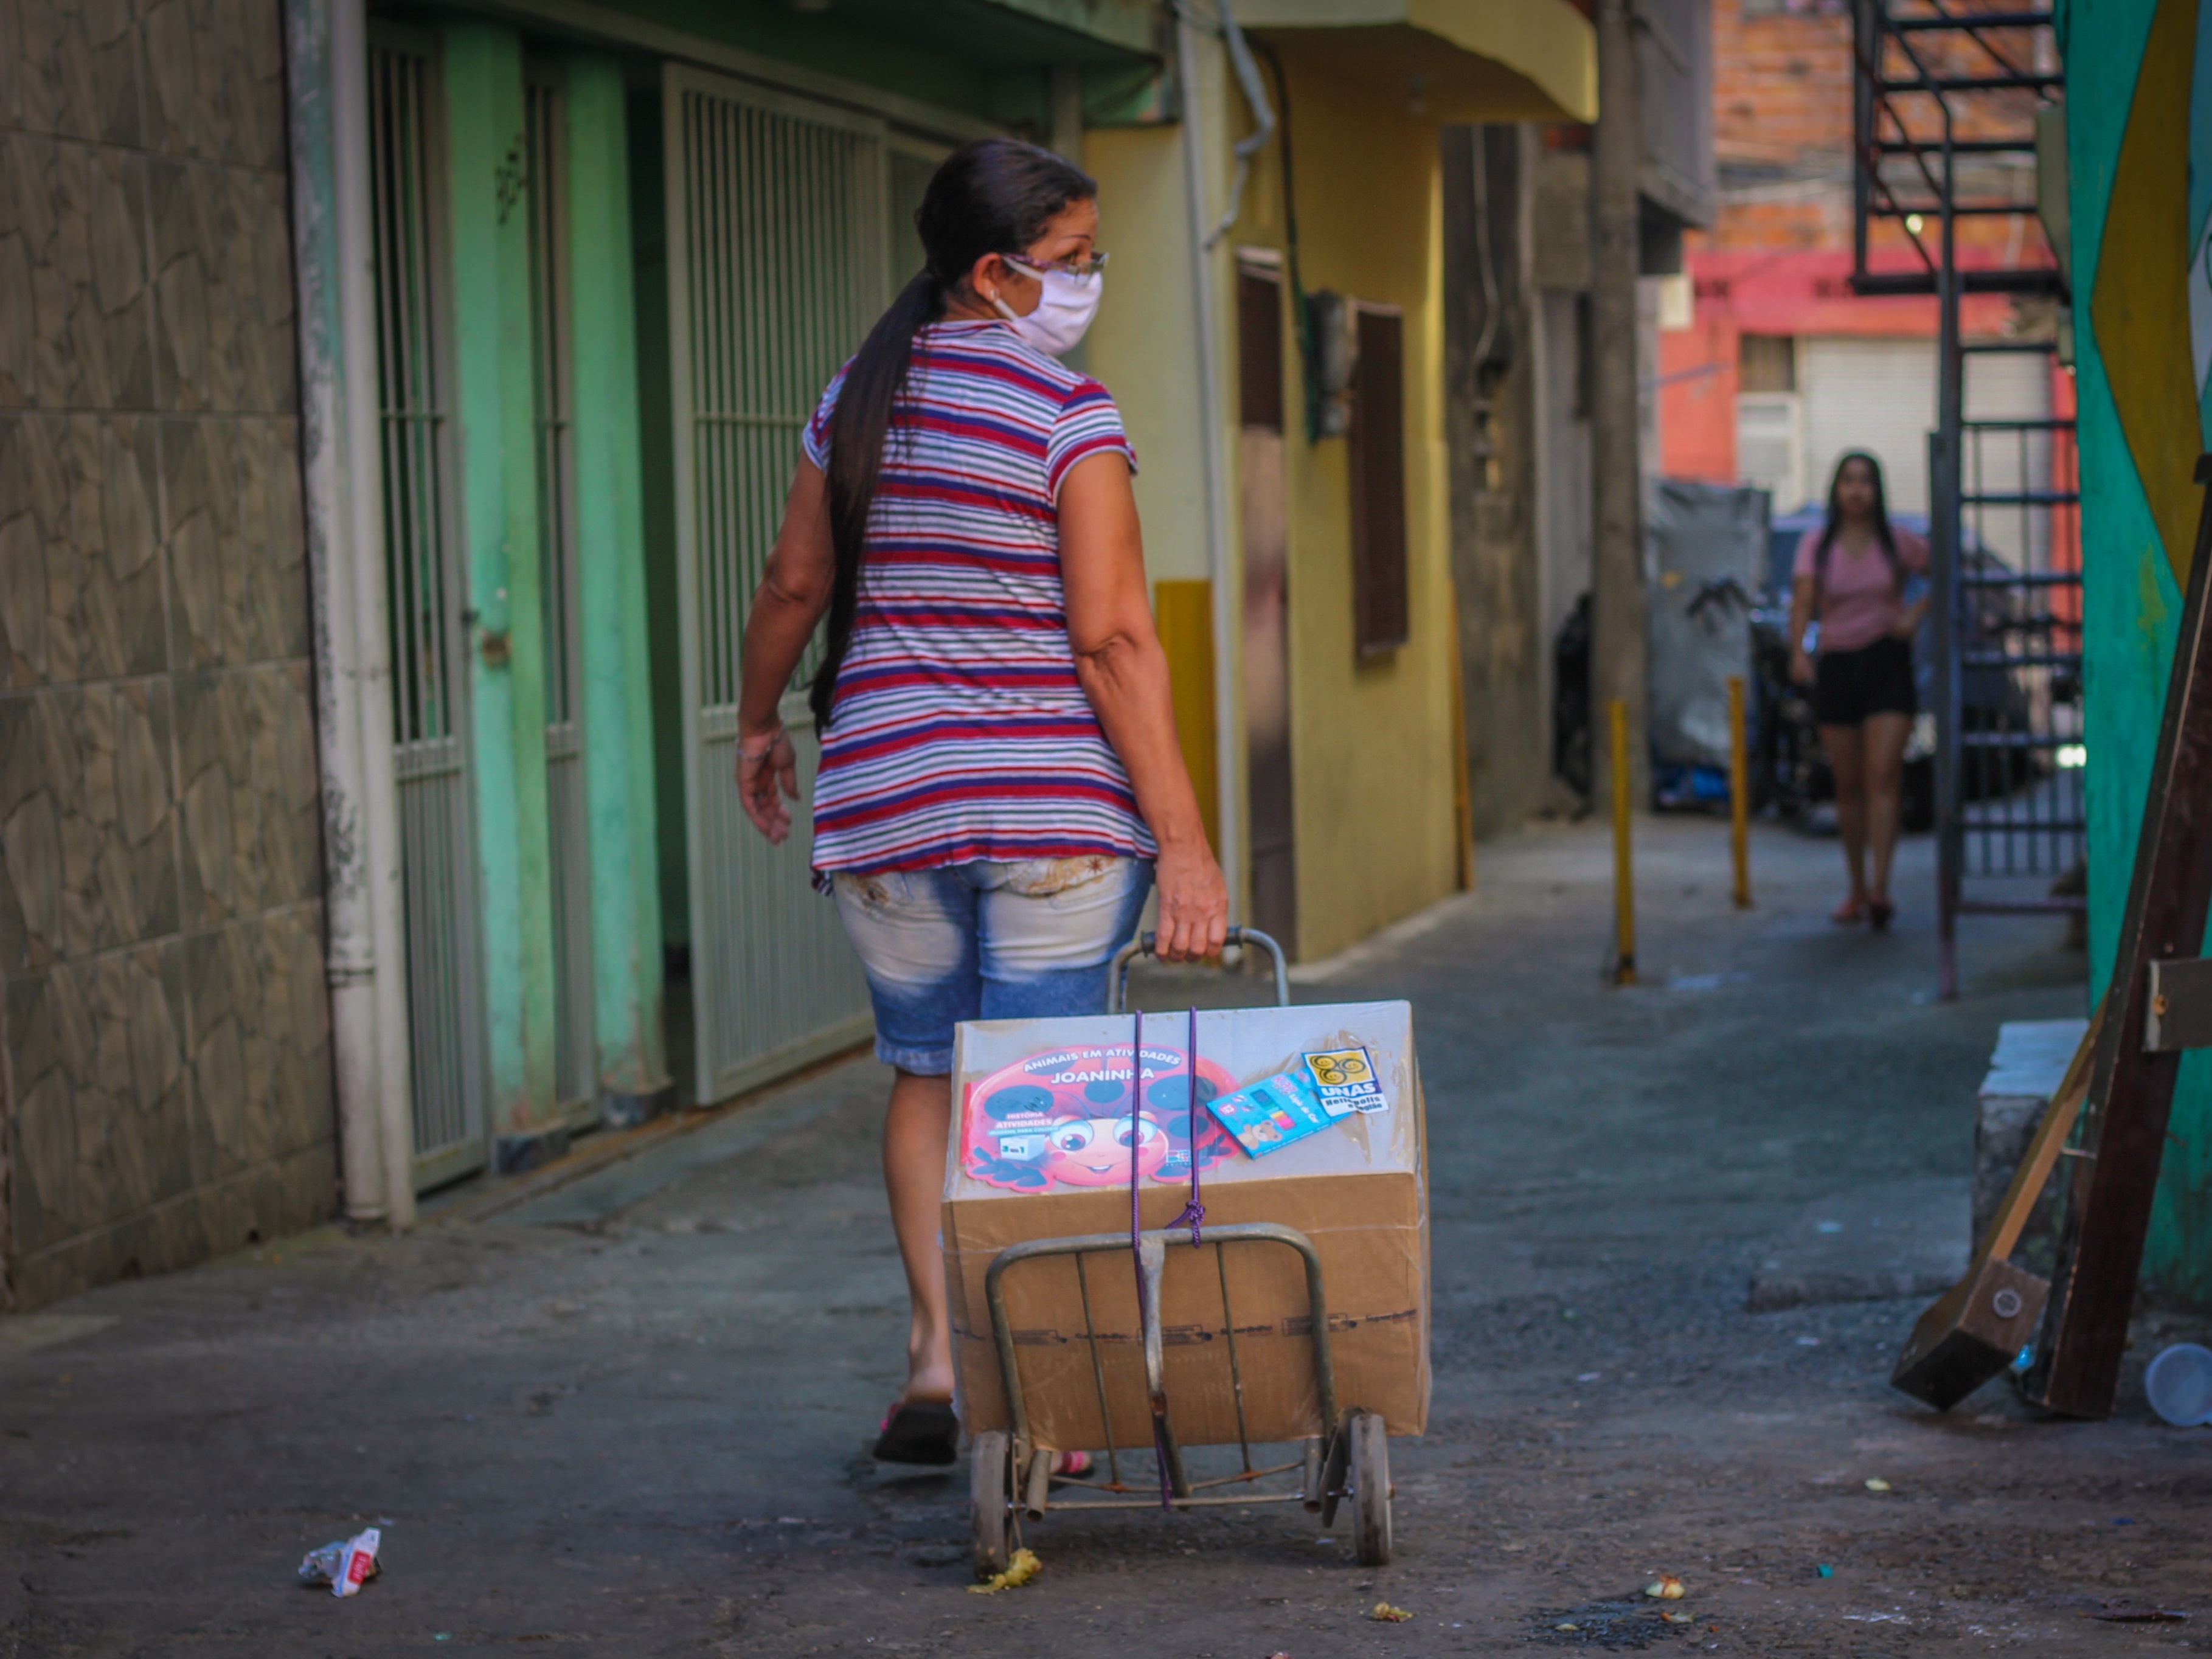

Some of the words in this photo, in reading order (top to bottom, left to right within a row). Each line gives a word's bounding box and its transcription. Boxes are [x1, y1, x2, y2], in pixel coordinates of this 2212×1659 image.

[1024, 1052, 1079, 1072] ANIMAIS
[1082, 1049, 1101, 1059] EM
[1106, 1048, 1181, 1065] ATIVDADES
[1320, 1082, 1376, 1097] UNAS
[995, 1118, 1053, 1129] ATIVIDADES
